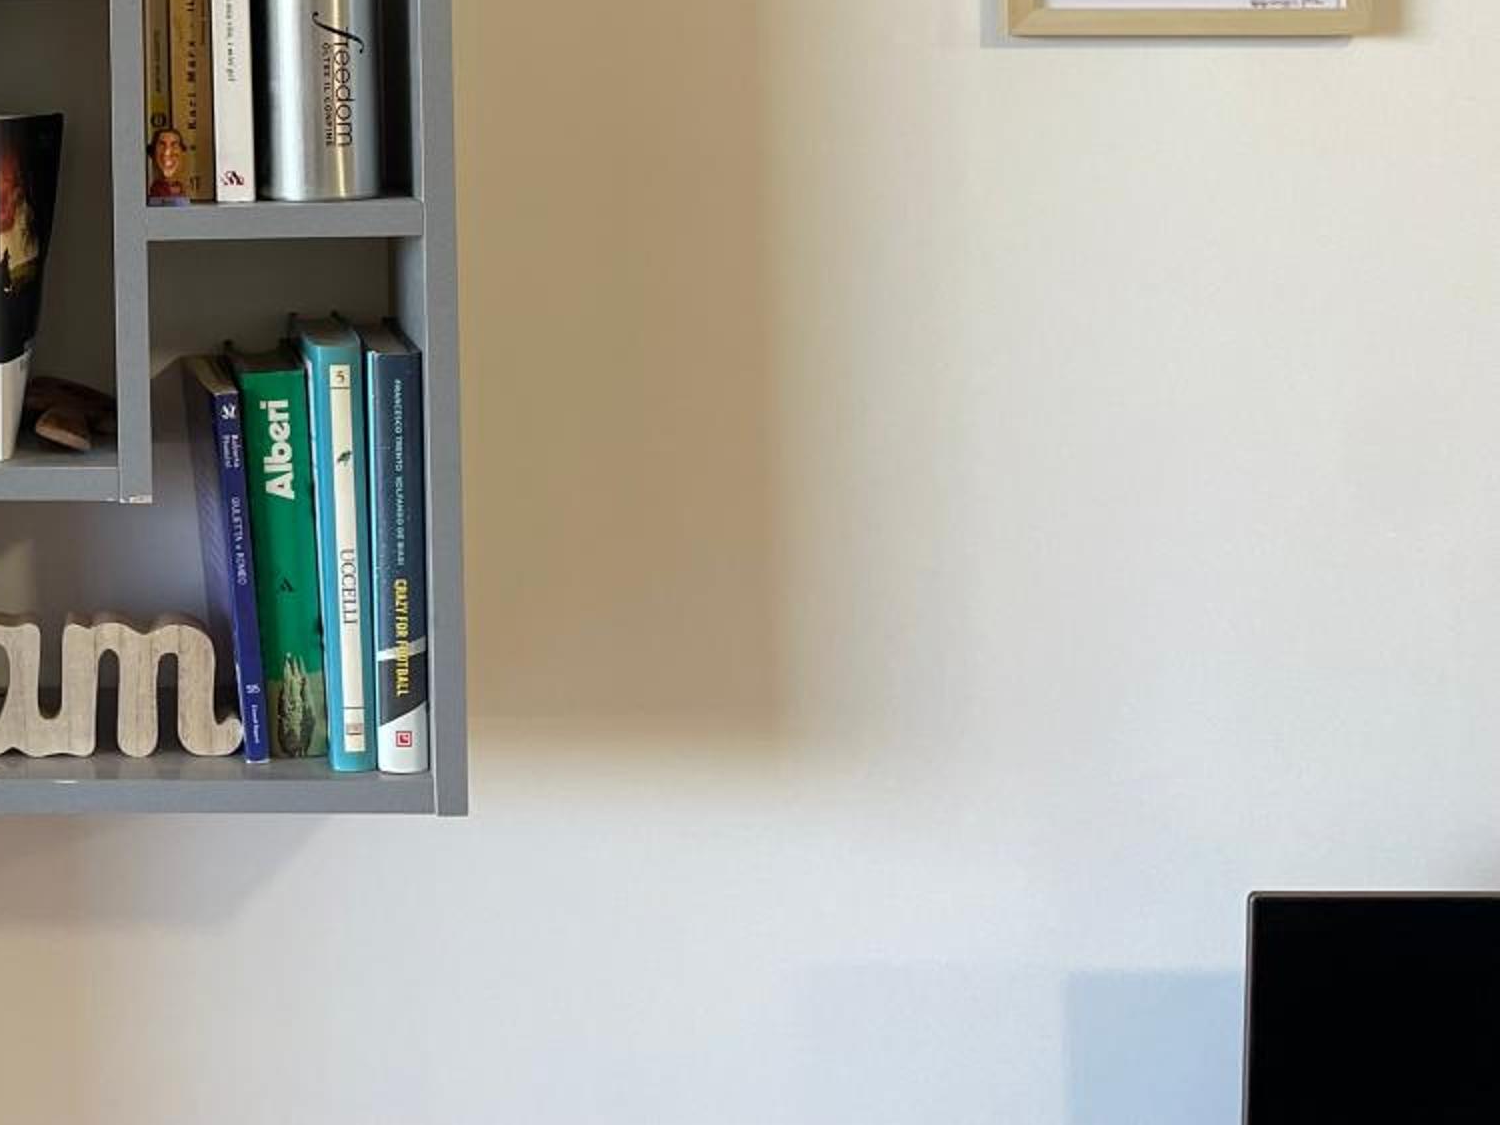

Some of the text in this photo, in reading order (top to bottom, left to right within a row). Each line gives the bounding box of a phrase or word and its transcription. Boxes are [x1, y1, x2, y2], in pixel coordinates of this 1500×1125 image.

[312, 11, 365, 147] freedom
[322, 42, 334, 147] OLTRE IL CONFINE
[335, 370, 345, 384] 5
[394, 378, 404, 434] FRANCESCO
[259, 399, 295, 500] Alberi
[394, 436, 403, 472] TRENTO
[235, 552, 248, 586] ROMEO
[339, 548, 358, 624] UCCELLI
[394, 578, 409, 698] CRAZY FOR FOOTBALL
